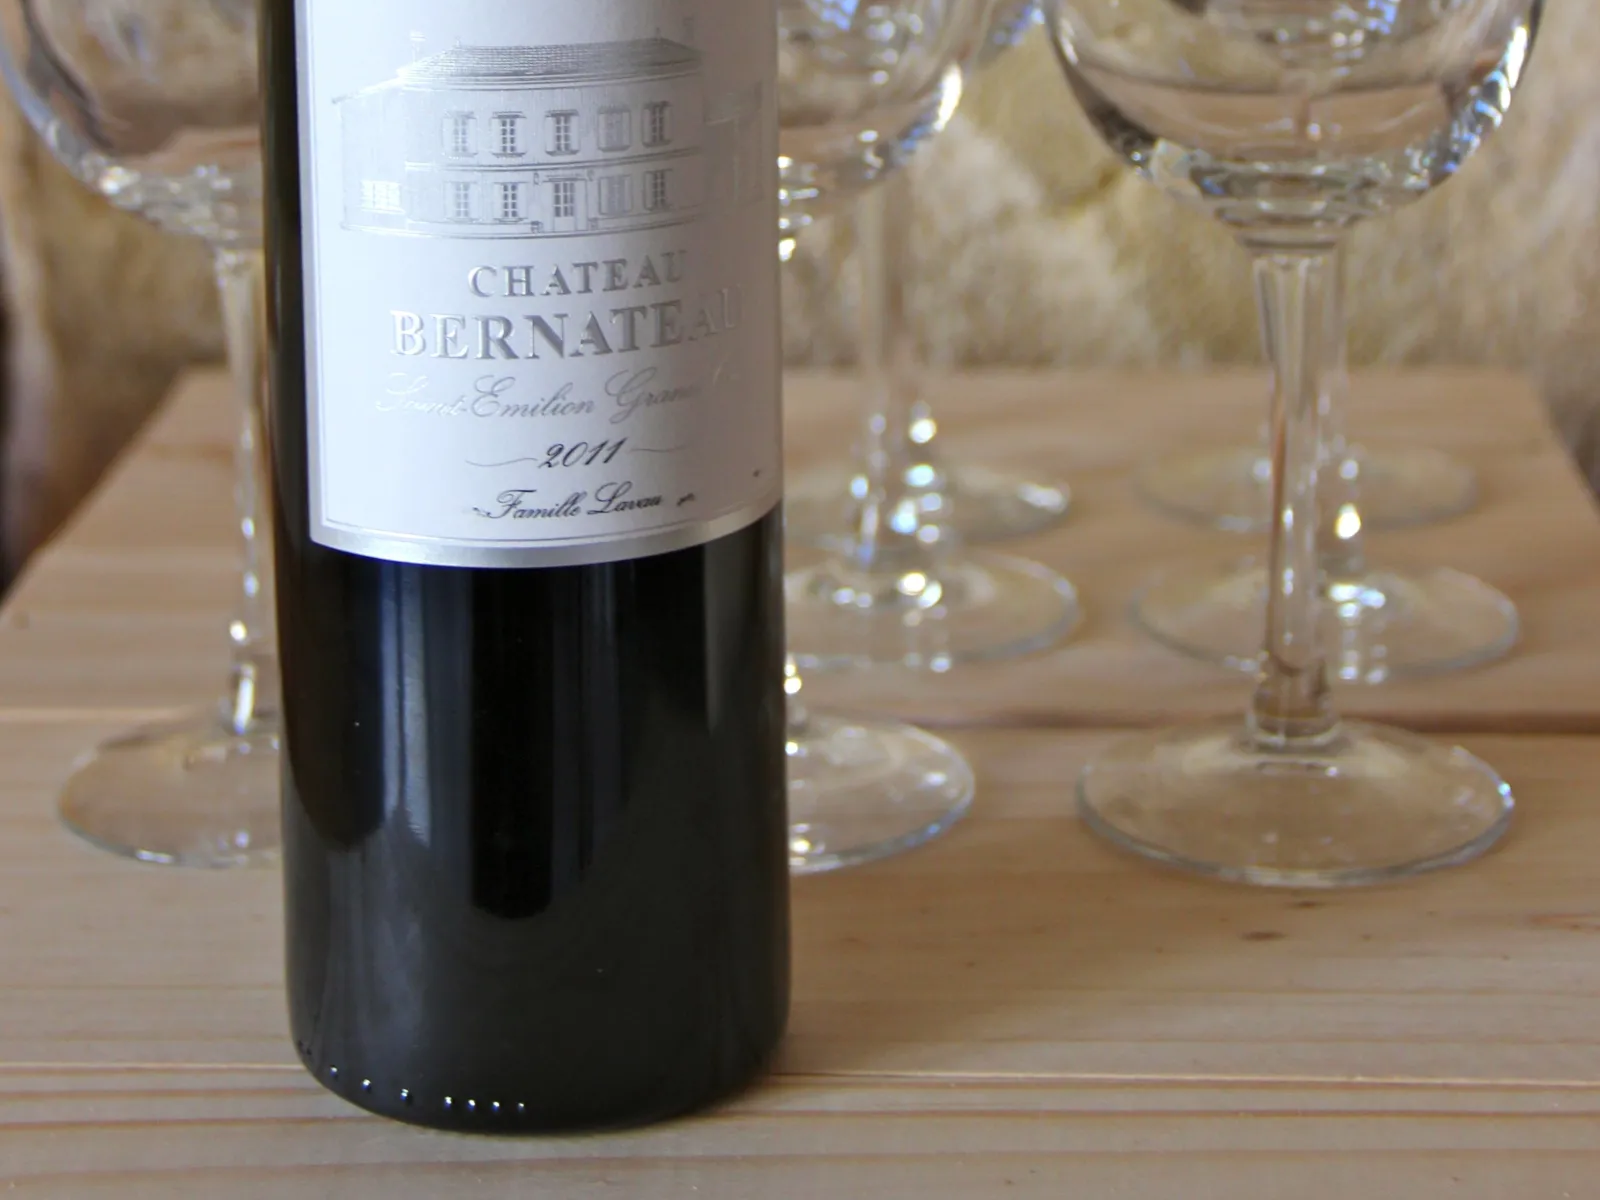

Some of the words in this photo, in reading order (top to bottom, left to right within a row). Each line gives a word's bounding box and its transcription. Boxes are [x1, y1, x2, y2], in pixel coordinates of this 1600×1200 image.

[467, 249, 688, 297] CHATEAU
[389, 282, 745, 360] BERNATEAU
[604, 366, 704, 424] Gran
[537, 436, 629, 469] 2011
[486, 488, 588, 519] Famille
